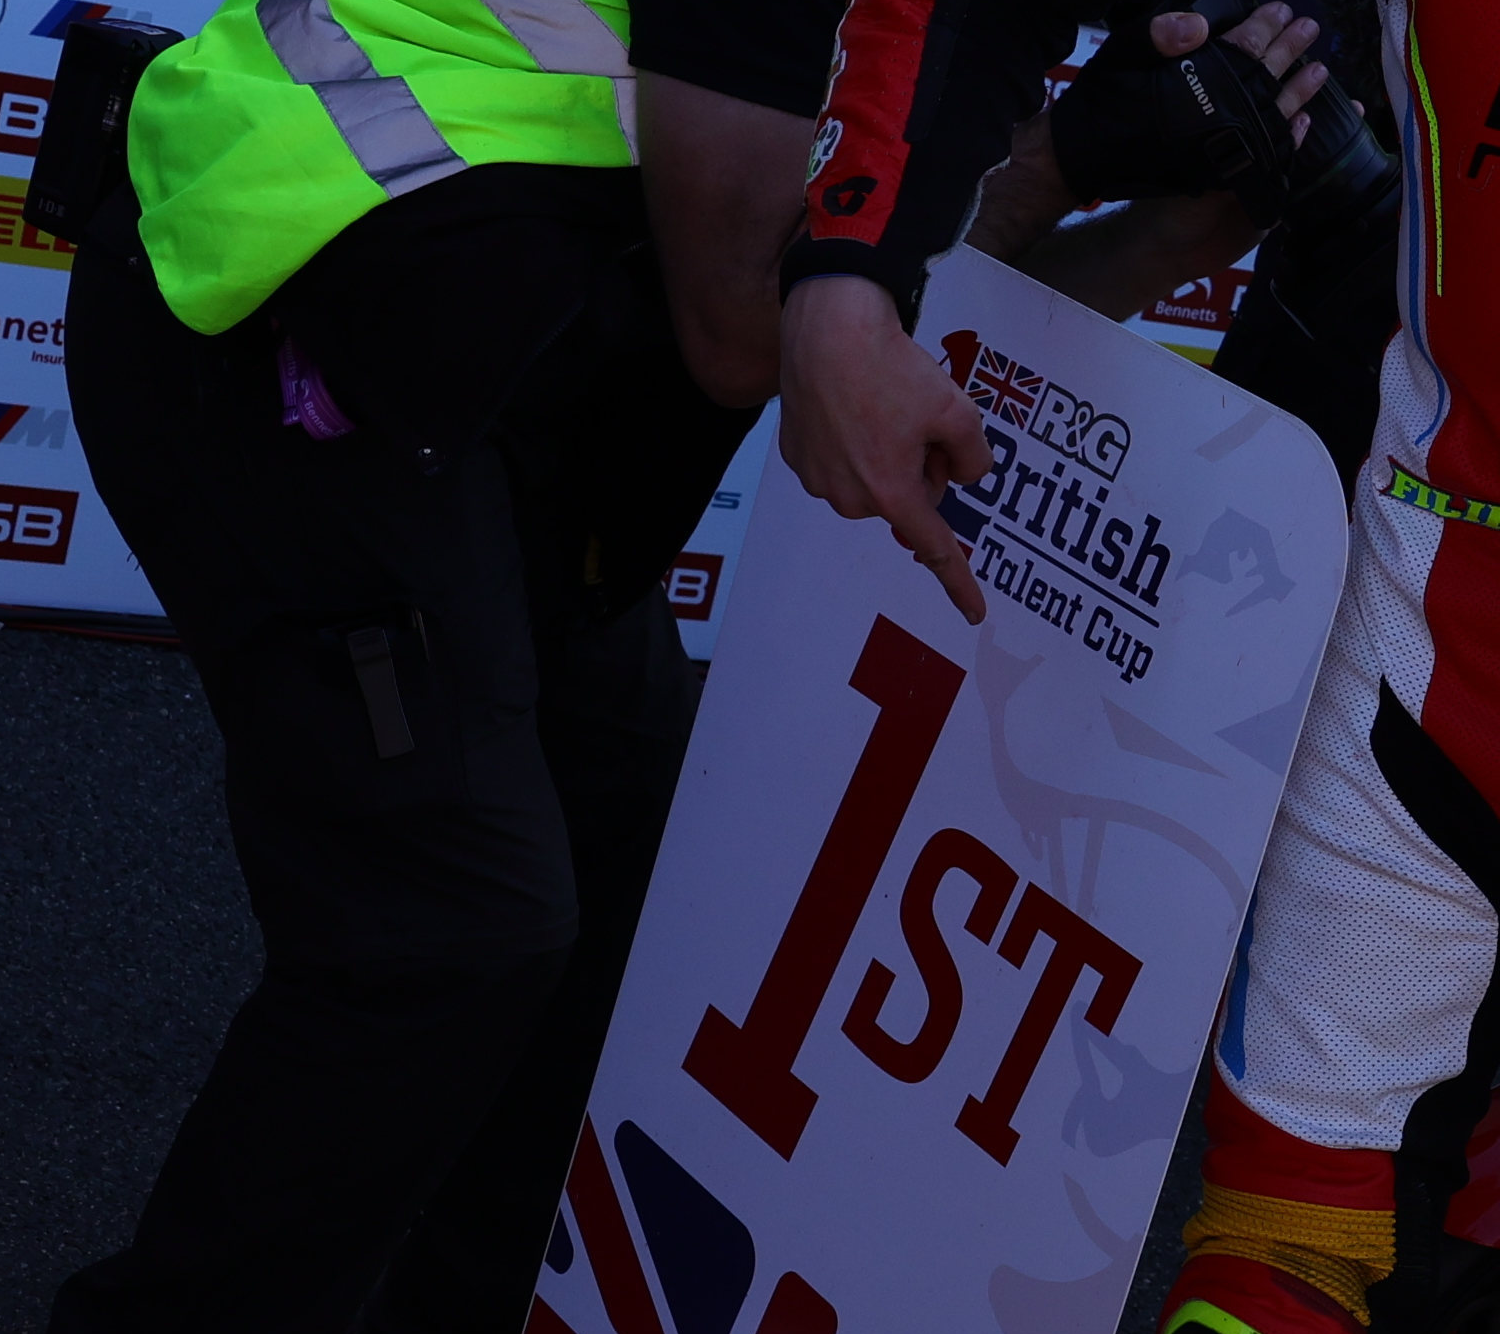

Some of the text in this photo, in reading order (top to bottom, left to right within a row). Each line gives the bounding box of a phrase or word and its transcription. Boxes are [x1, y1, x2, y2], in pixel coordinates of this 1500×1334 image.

[1180, 60, 1216, 116] Canon
[31, 350, 66, 367] Insur
[1154, 300, 1218, 323] Bennetts
[1033, 386, 1132, 481] R&G
[962, 435, 1172, 606] British
[977, 537, 1156, 683] Talent Cup
[682, 613, 1144, 1167] 1ST
